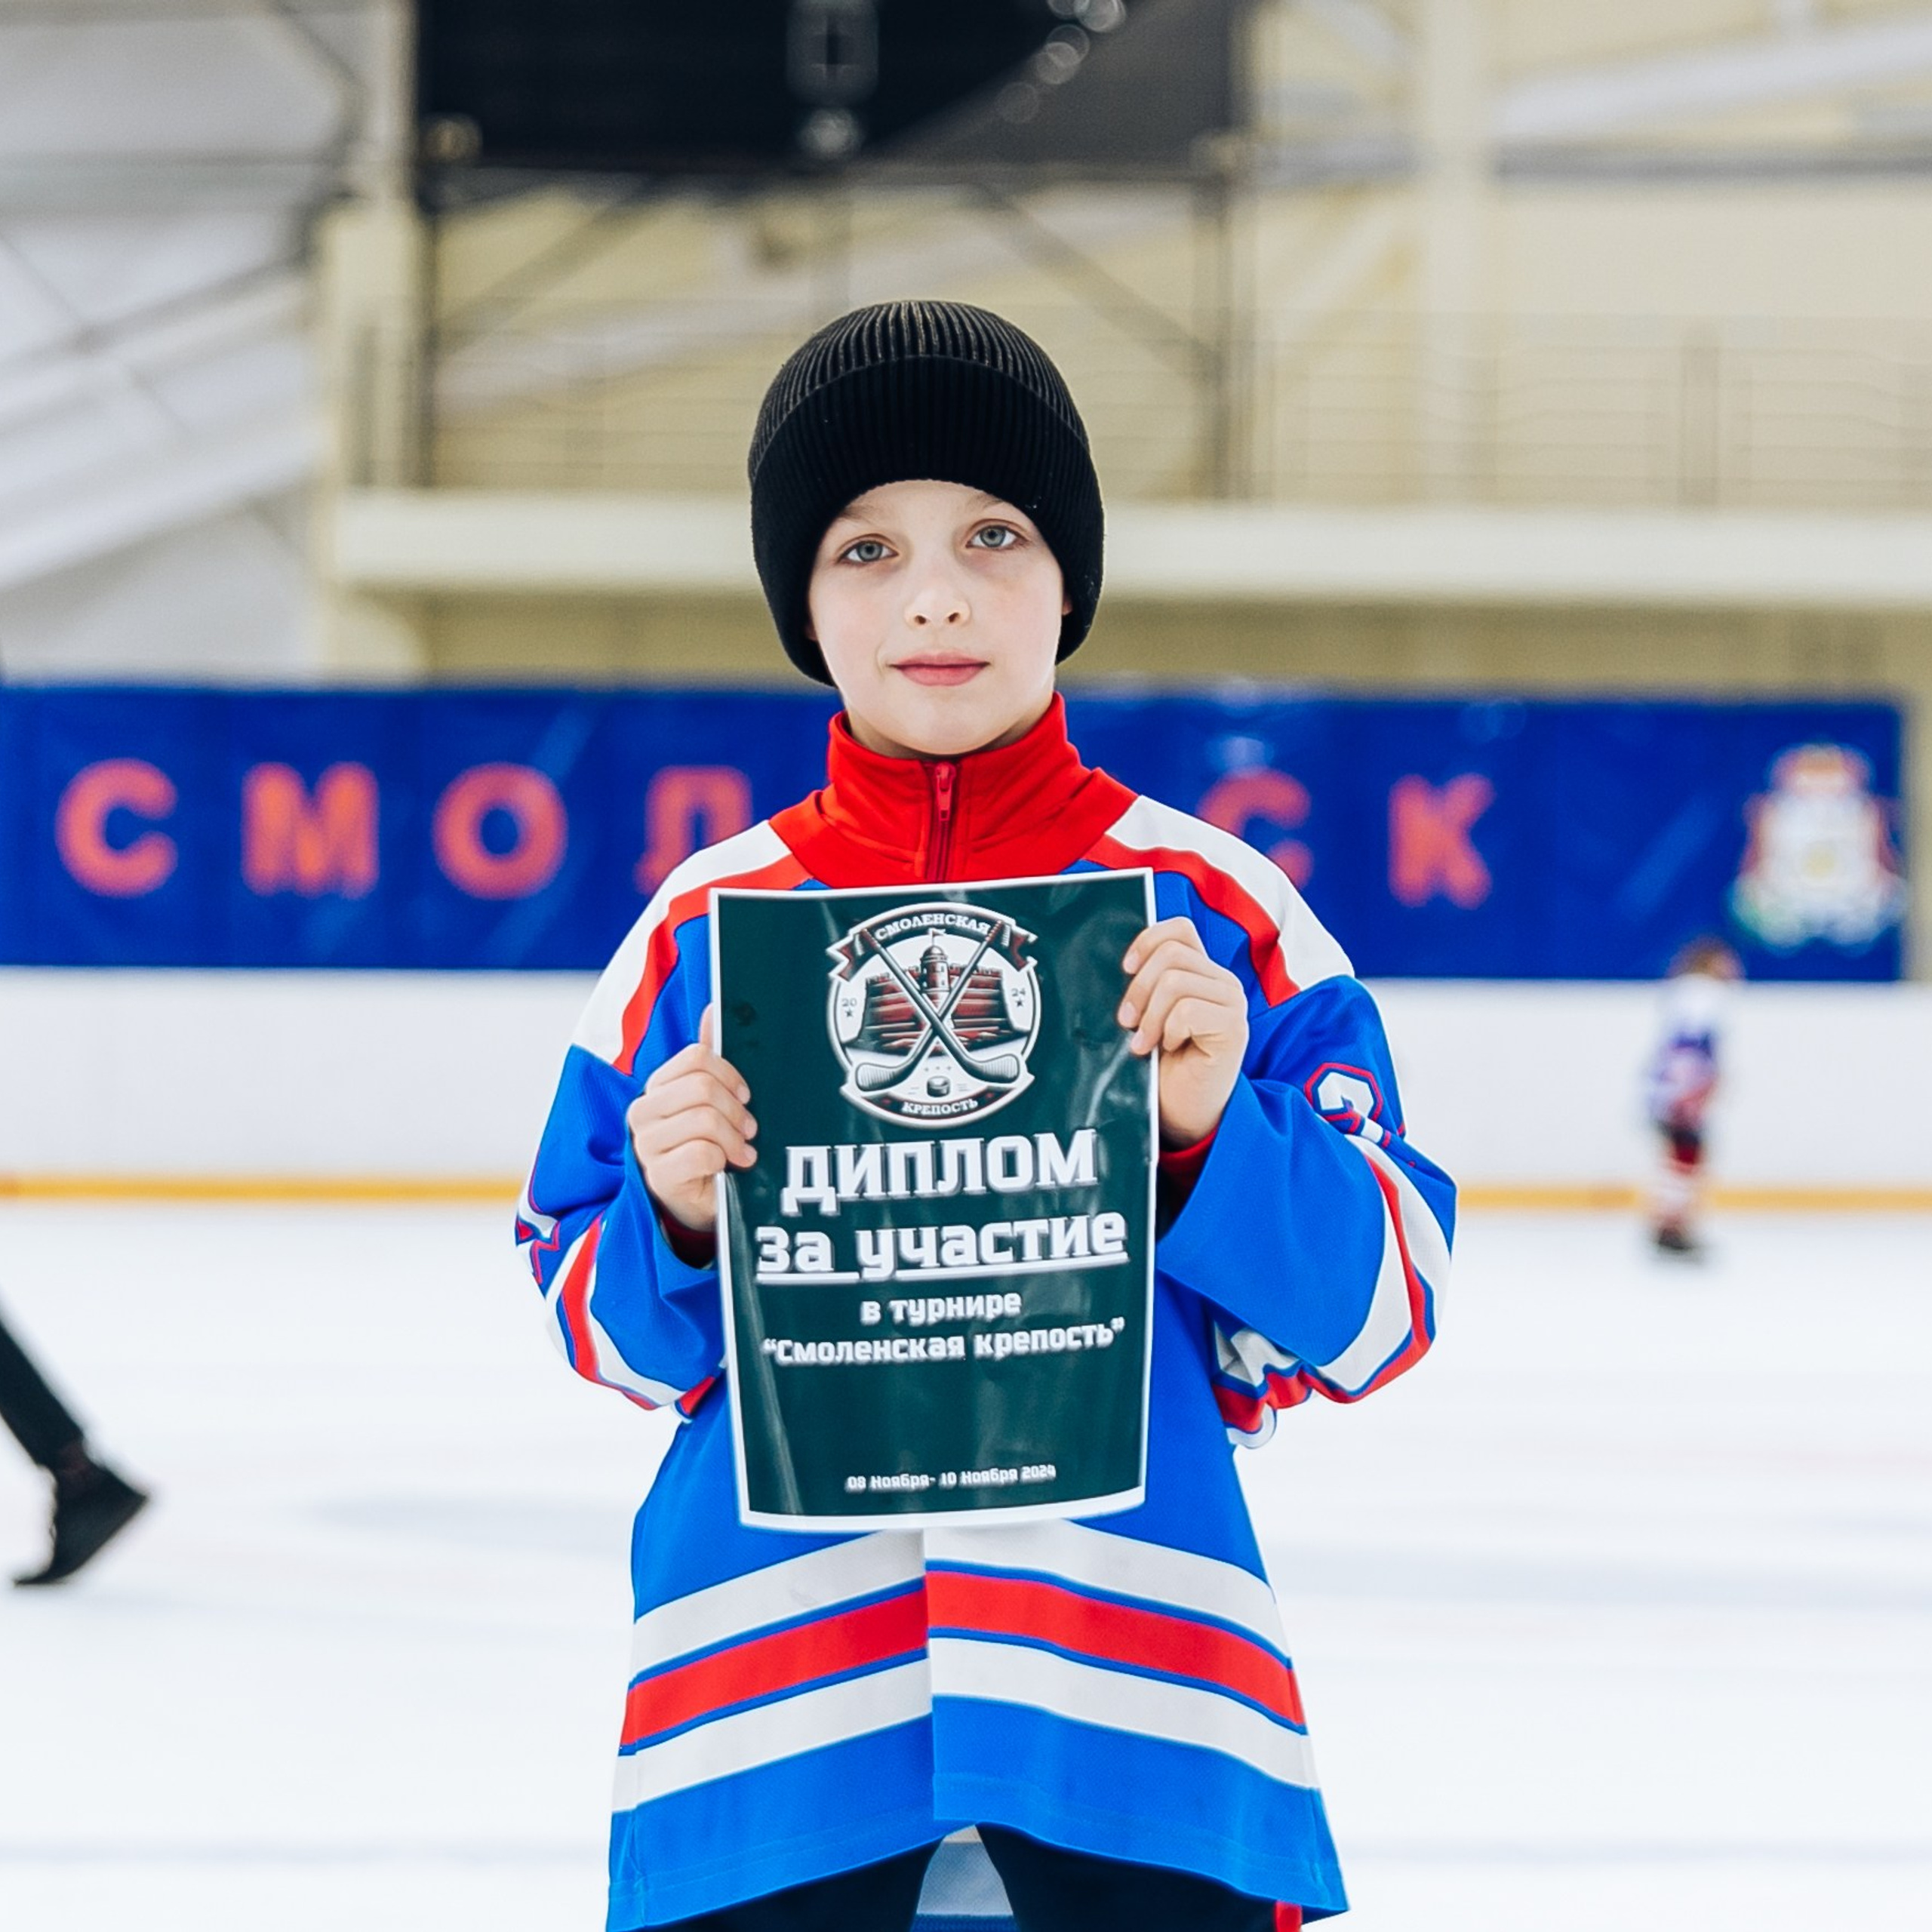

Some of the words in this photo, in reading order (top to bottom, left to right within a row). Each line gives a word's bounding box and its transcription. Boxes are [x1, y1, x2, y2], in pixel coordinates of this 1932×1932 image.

[55, 758, 1495, 909] СМОЛСК
[875, 913, 991, 940] СМОЛЕНСКАЯ
[841, 998, 857, 1008] 20
[1011, 987, 1027, 997] 24
[901, 1098, 979, 1115] КРЕПОСТЬ
[781, 1129, 1099, 1216] ДИПЛОМ
[756, 1226, 834, 1273] За
[855, 1211, 1128, 1281] участие
[860, 1300, 881, 1325] в
[888, 1293, 1022, 1326] турнире
[760, 1337, 966, 1366] “Смоленская
[846, 1475, 866, 1491] 08
[940, 1472, 957, 1487] 10
[960, 1468, 1018, 1486] Ноября
[1020, 1464, 1056, 1481] 2024
